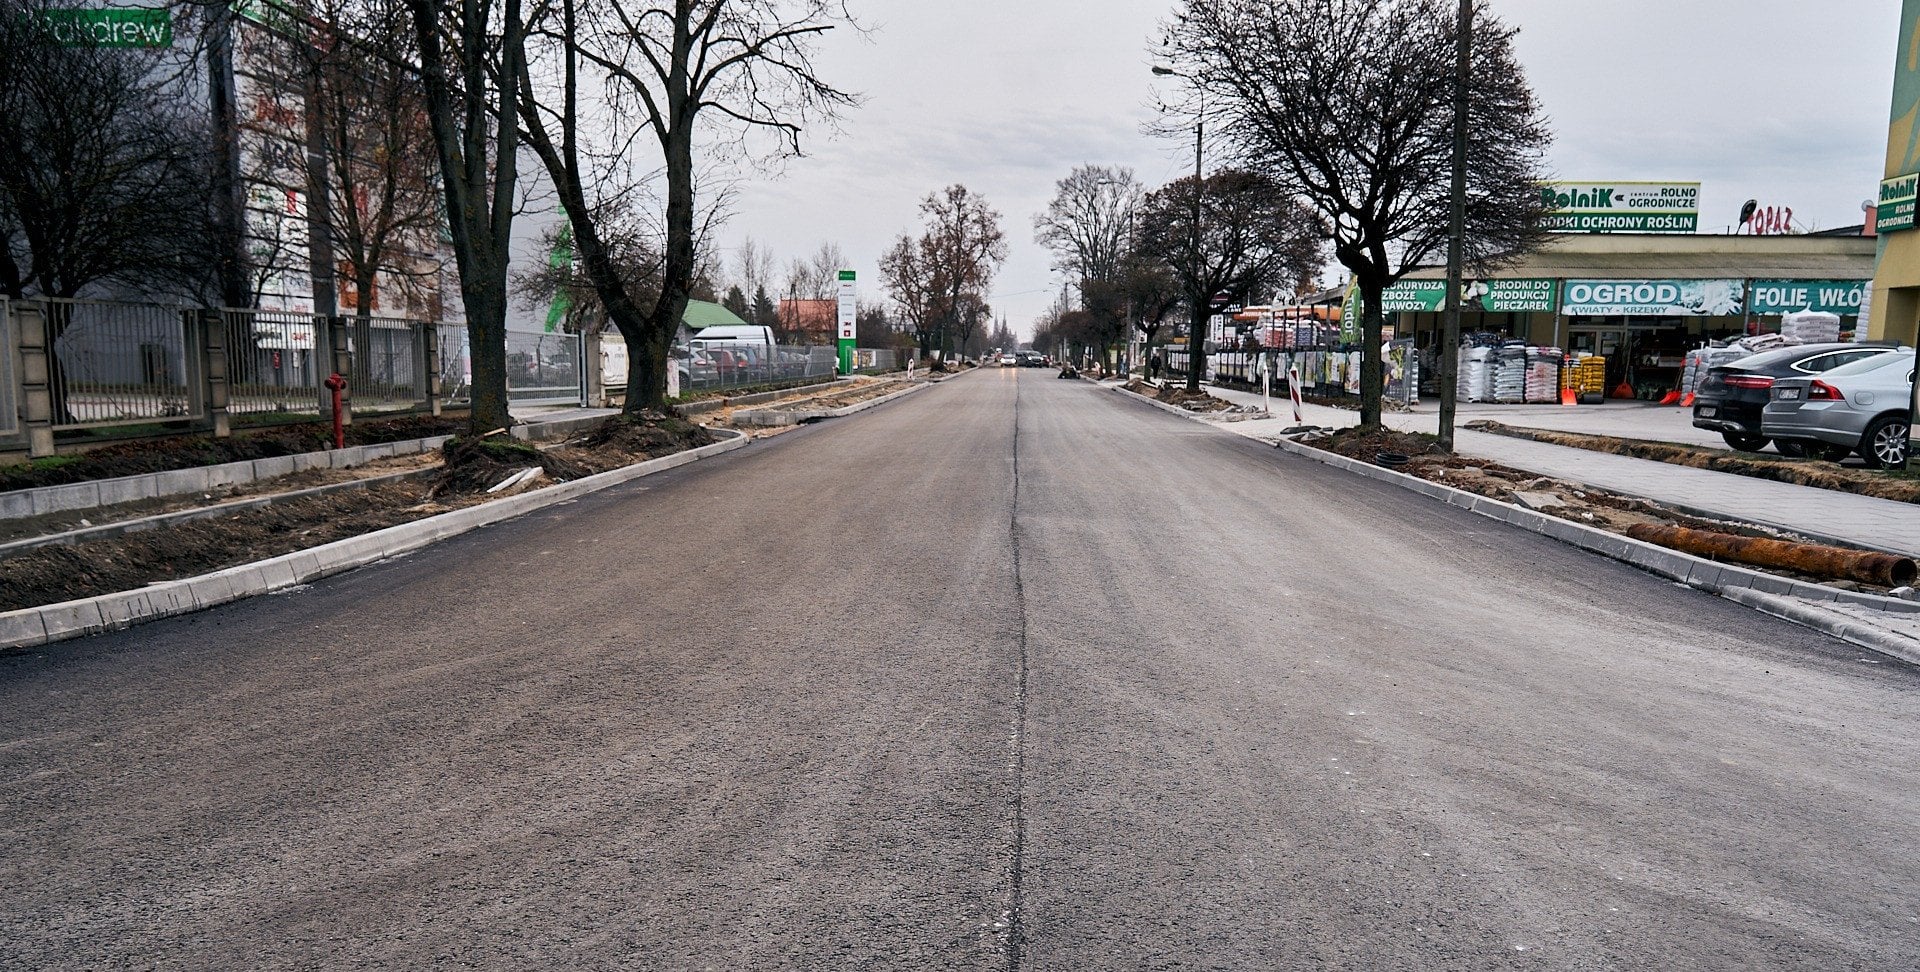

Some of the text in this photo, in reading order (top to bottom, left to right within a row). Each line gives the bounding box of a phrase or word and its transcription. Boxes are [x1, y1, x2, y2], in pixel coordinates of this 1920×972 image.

[1661, 188, 1697, 197] ROLNO
[1629, 198, 1695, 208] OGRODNICZE
[1895, 203, 1915, 214] ROLNO
[1533, 214, 1693, 228] RODKI OCHRONY ROŚLIN
[1746, 205, 1792, 234] TOPAZ
[1878, 214, 1914, 228] OGRODNICZE
[1383, 281, 1444, 290] UKURYDZA
[1494, 280, 1550, 290] ŚRODKI DO
[1382, 290, 1416, 300] ZBOŻE
[1491, 291, 1549, 300] PRODUKCJI
[1570, 282, 1678, 304] OGRÓD
[1382, 301, 1427, 310] NAWOZY
[1494, 301, 1548, 310] PIECZAREK
[1571, 306, 1613, 314] KWIATY
[1623, 306, 1668, 314] KRZEWY
[1344, 294, 1355, 335] Tudor
